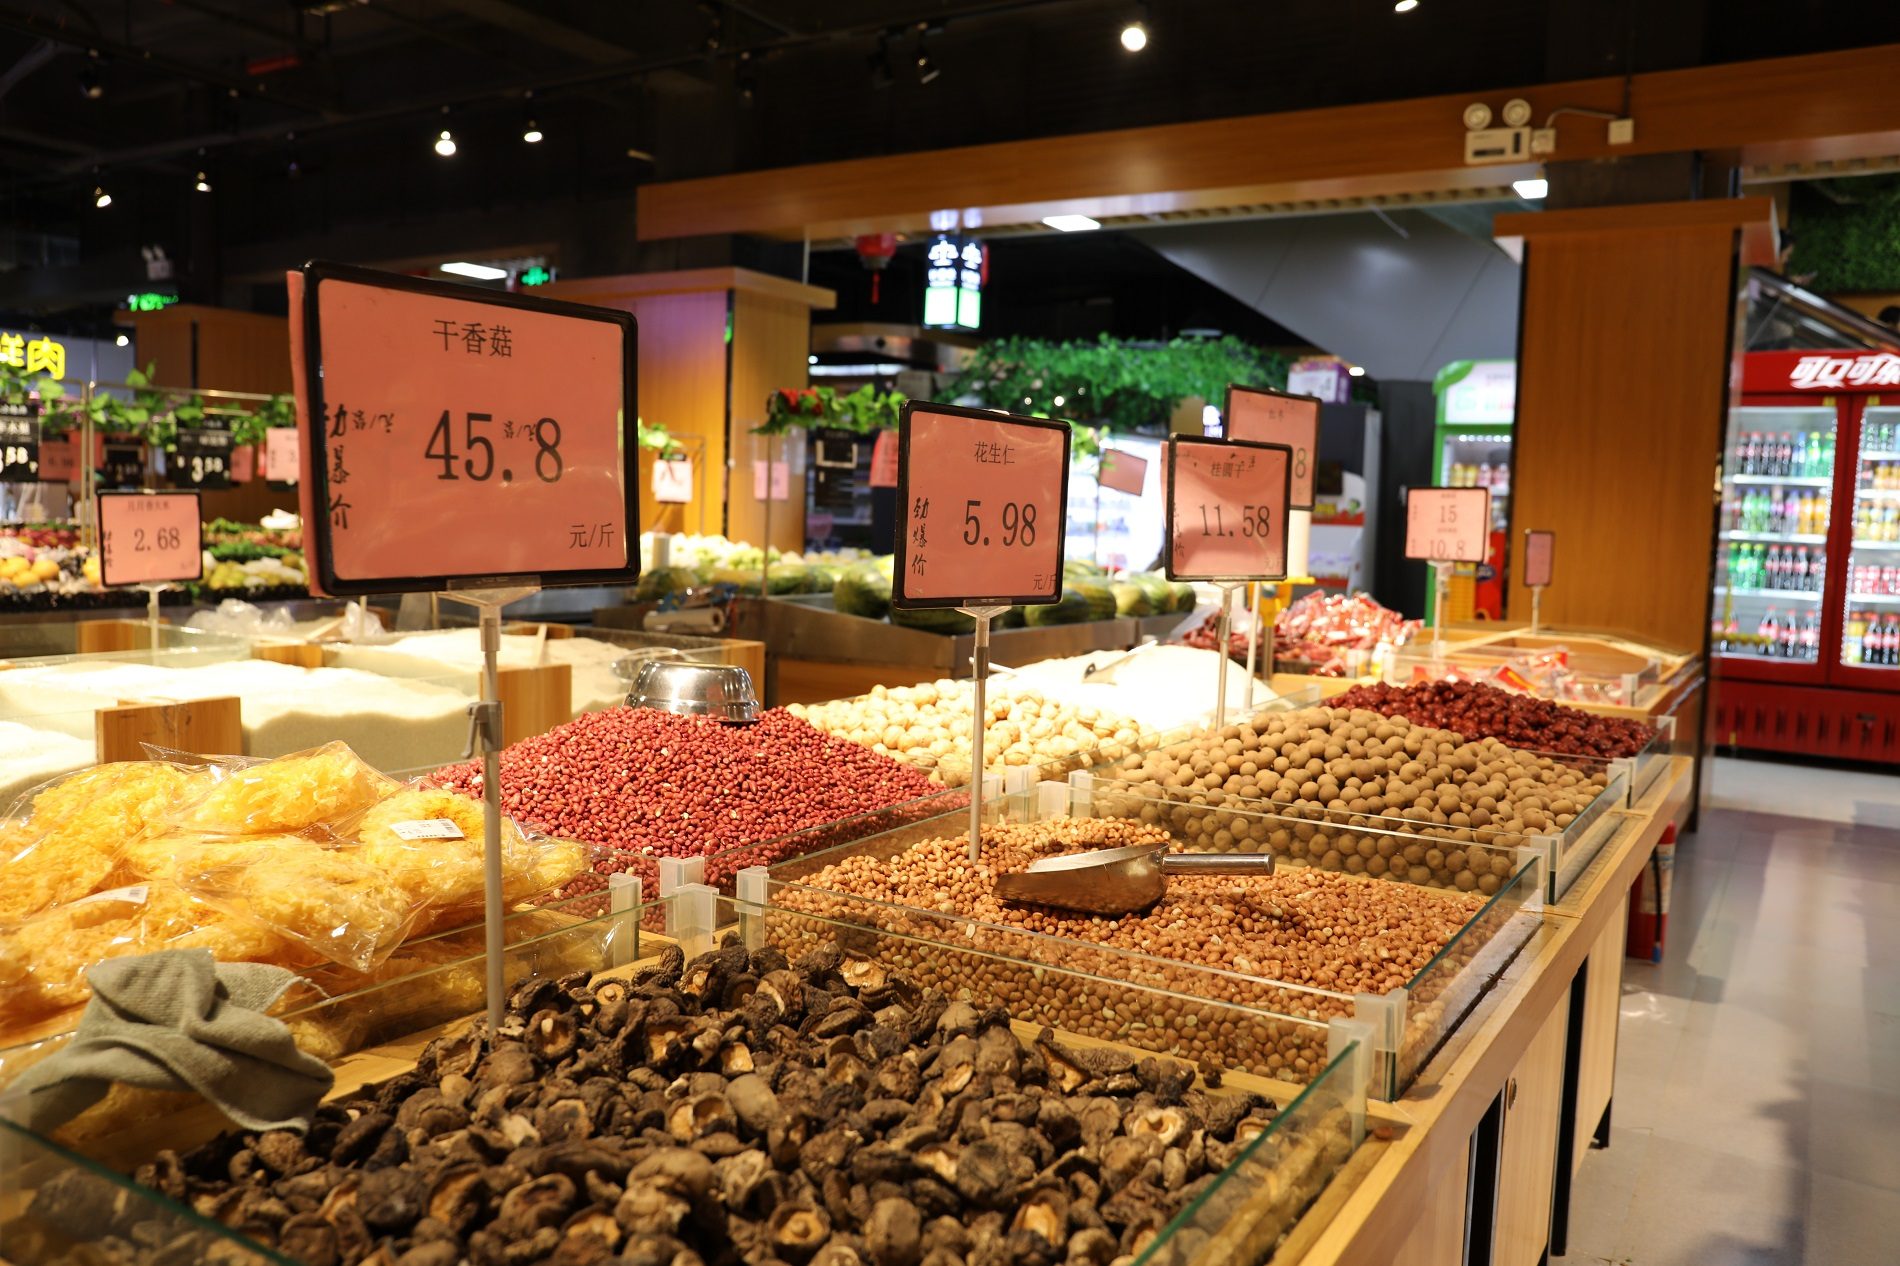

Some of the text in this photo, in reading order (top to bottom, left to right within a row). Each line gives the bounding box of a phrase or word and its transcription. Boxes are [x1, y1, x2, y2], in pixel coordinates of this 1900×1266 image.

[432, 320, 512, 357] 干香菇
[425, 409, 563, 482] 45.8
[974, 441, 1015, 465] 花生仁
[963, 500, 1036, 547] 5.98
[1199, 504, 1270, 537] 11.58
[1440, 505, 1457, 523] 15
[134, 527, 181, 552] 2.68
[569, 522, 615, 549] 元/斤
[911, 497, 930, 577] 劲爆价
